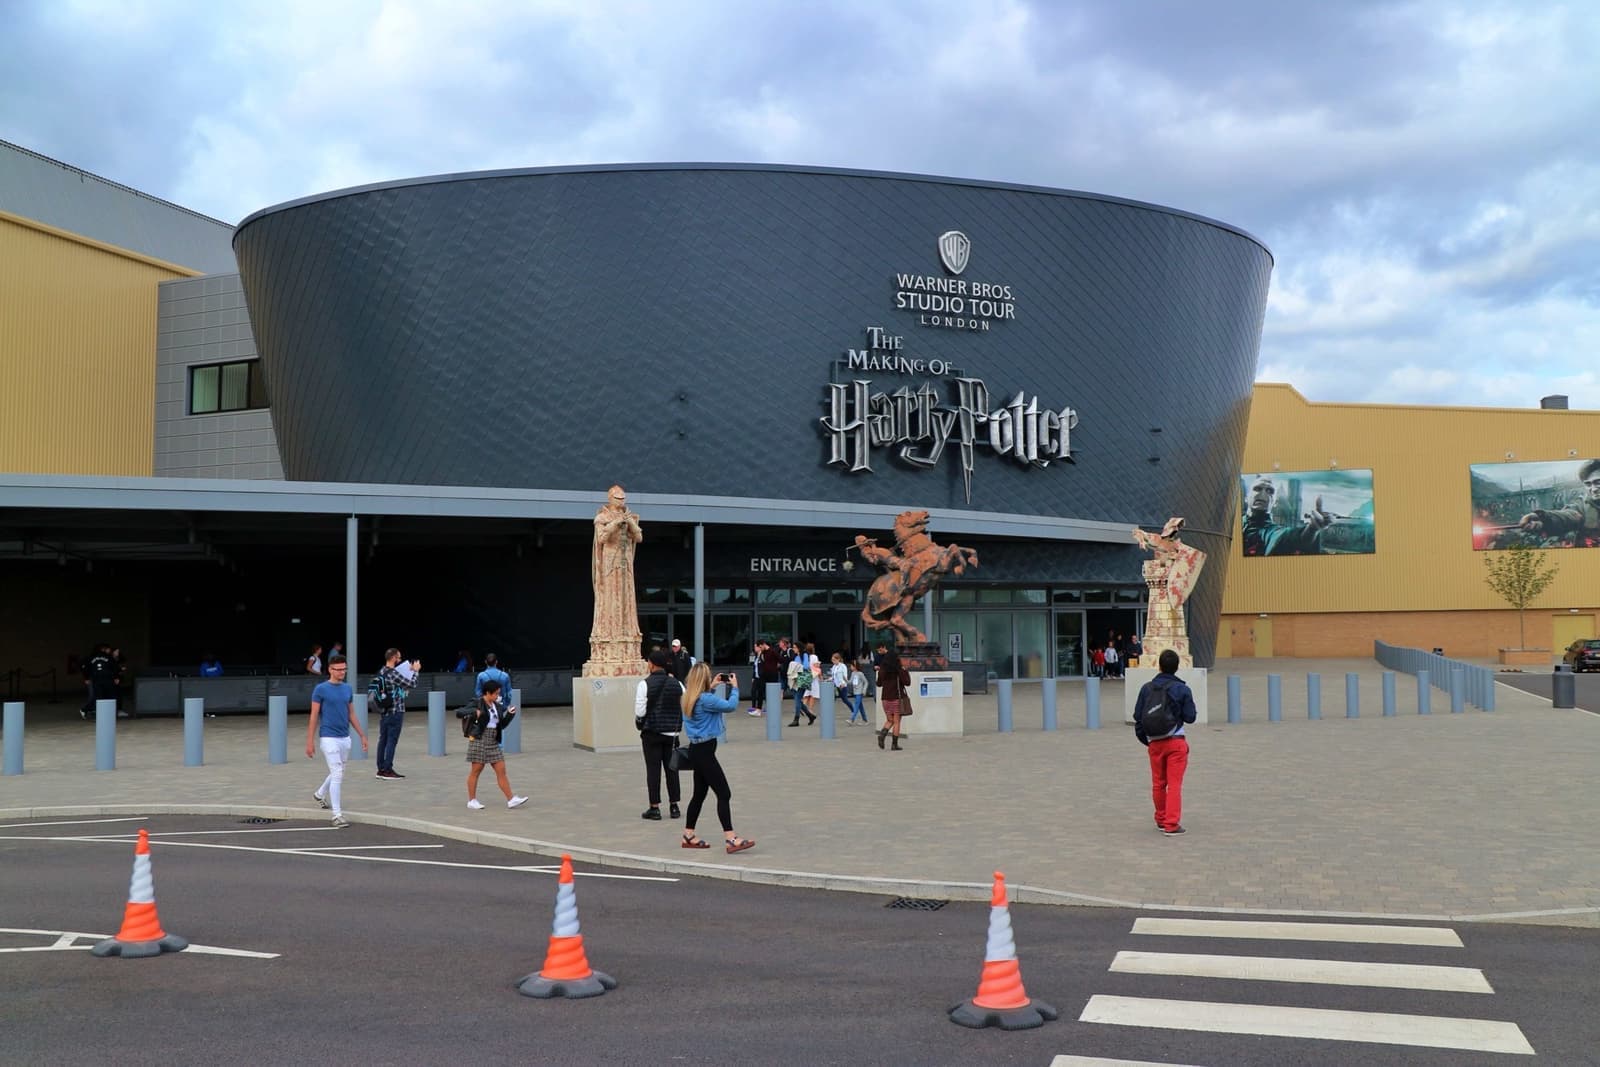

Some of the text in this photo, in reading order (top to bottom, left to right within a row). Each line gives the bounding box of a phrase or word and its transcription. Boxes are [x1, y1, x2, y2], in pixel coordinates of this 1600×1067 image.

[942, 234, 968, 269] WB
[897, 273, 1016, 301] WARNER BROS.
[897, 292, 1015, 319] STUDIO TOUR
[921, 315, 989, 330] LONDON
[929, 359, 953, 375] OF
[820, 377, 1079, 505] Harry Potter
[750, 558, 837, 573] ENTRANCE
